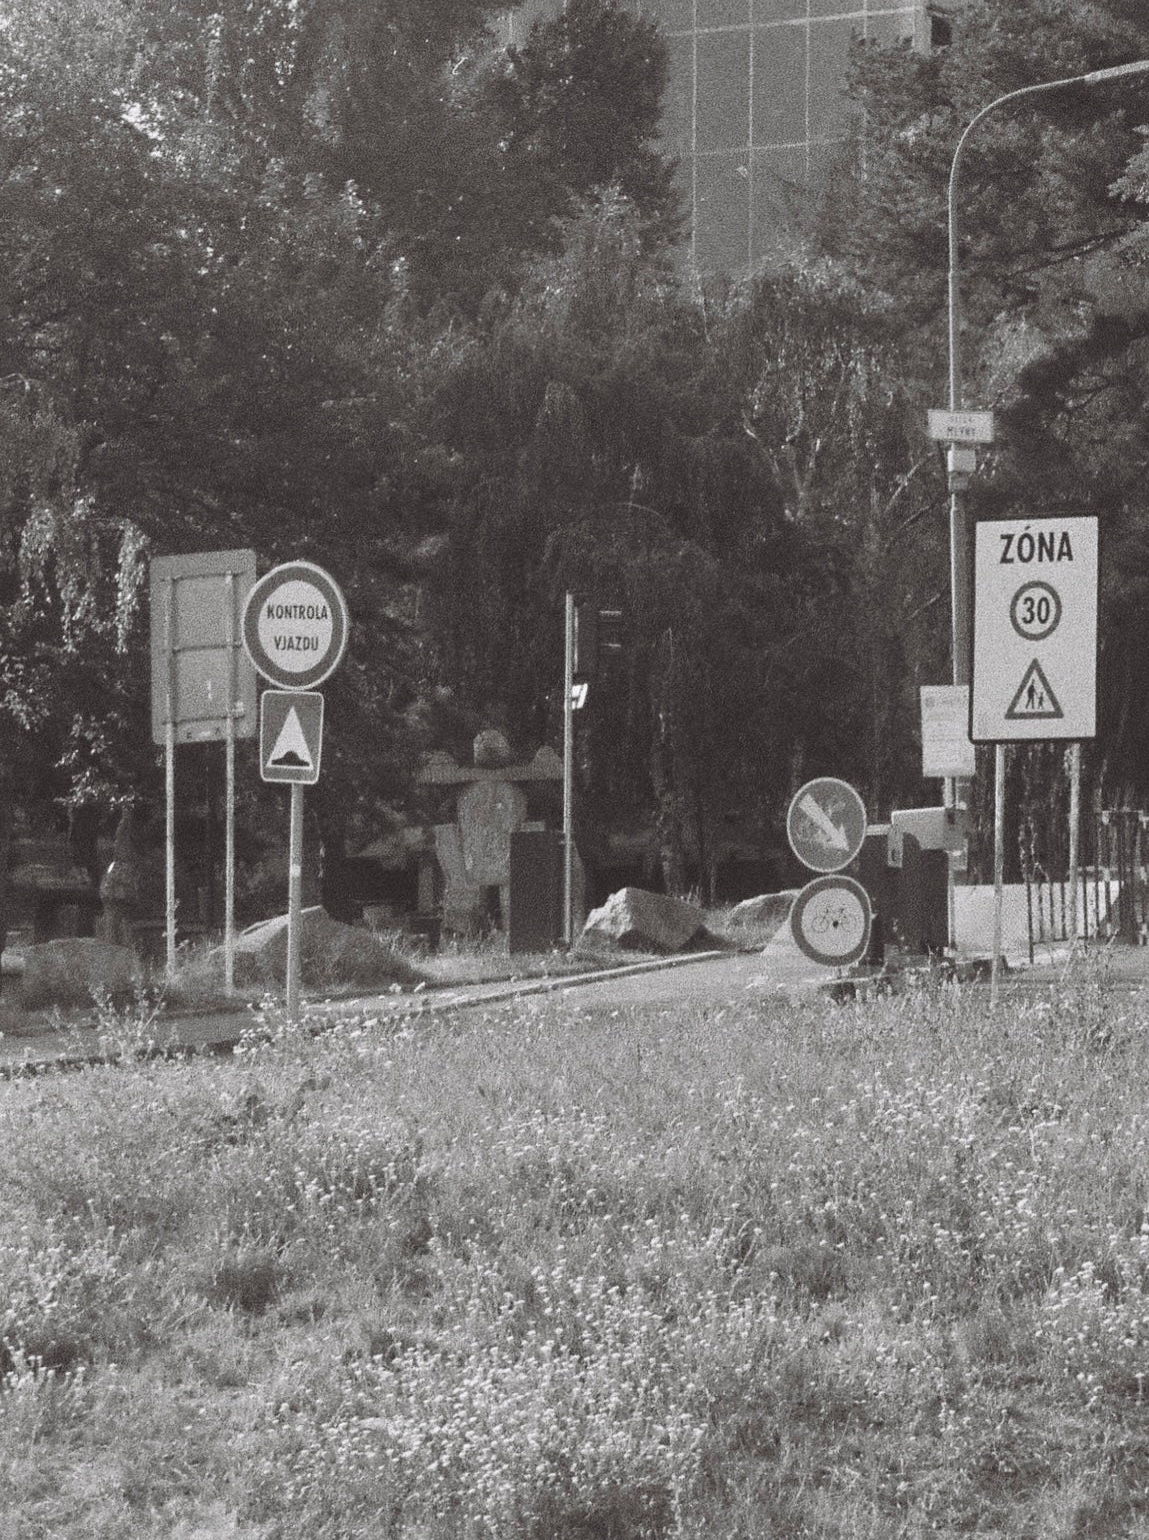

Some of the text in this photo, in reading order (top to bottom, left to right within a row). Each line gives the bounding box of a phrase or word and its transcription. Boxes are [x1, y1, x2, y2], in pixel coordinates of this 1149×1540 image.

[999, 525, 1074, 564] ZÓNA
[266, 605, 328, 619] KONTROLA
[1021, 596, 1050, 624] 30
[274, 635, 319, 651] VJAZDU
